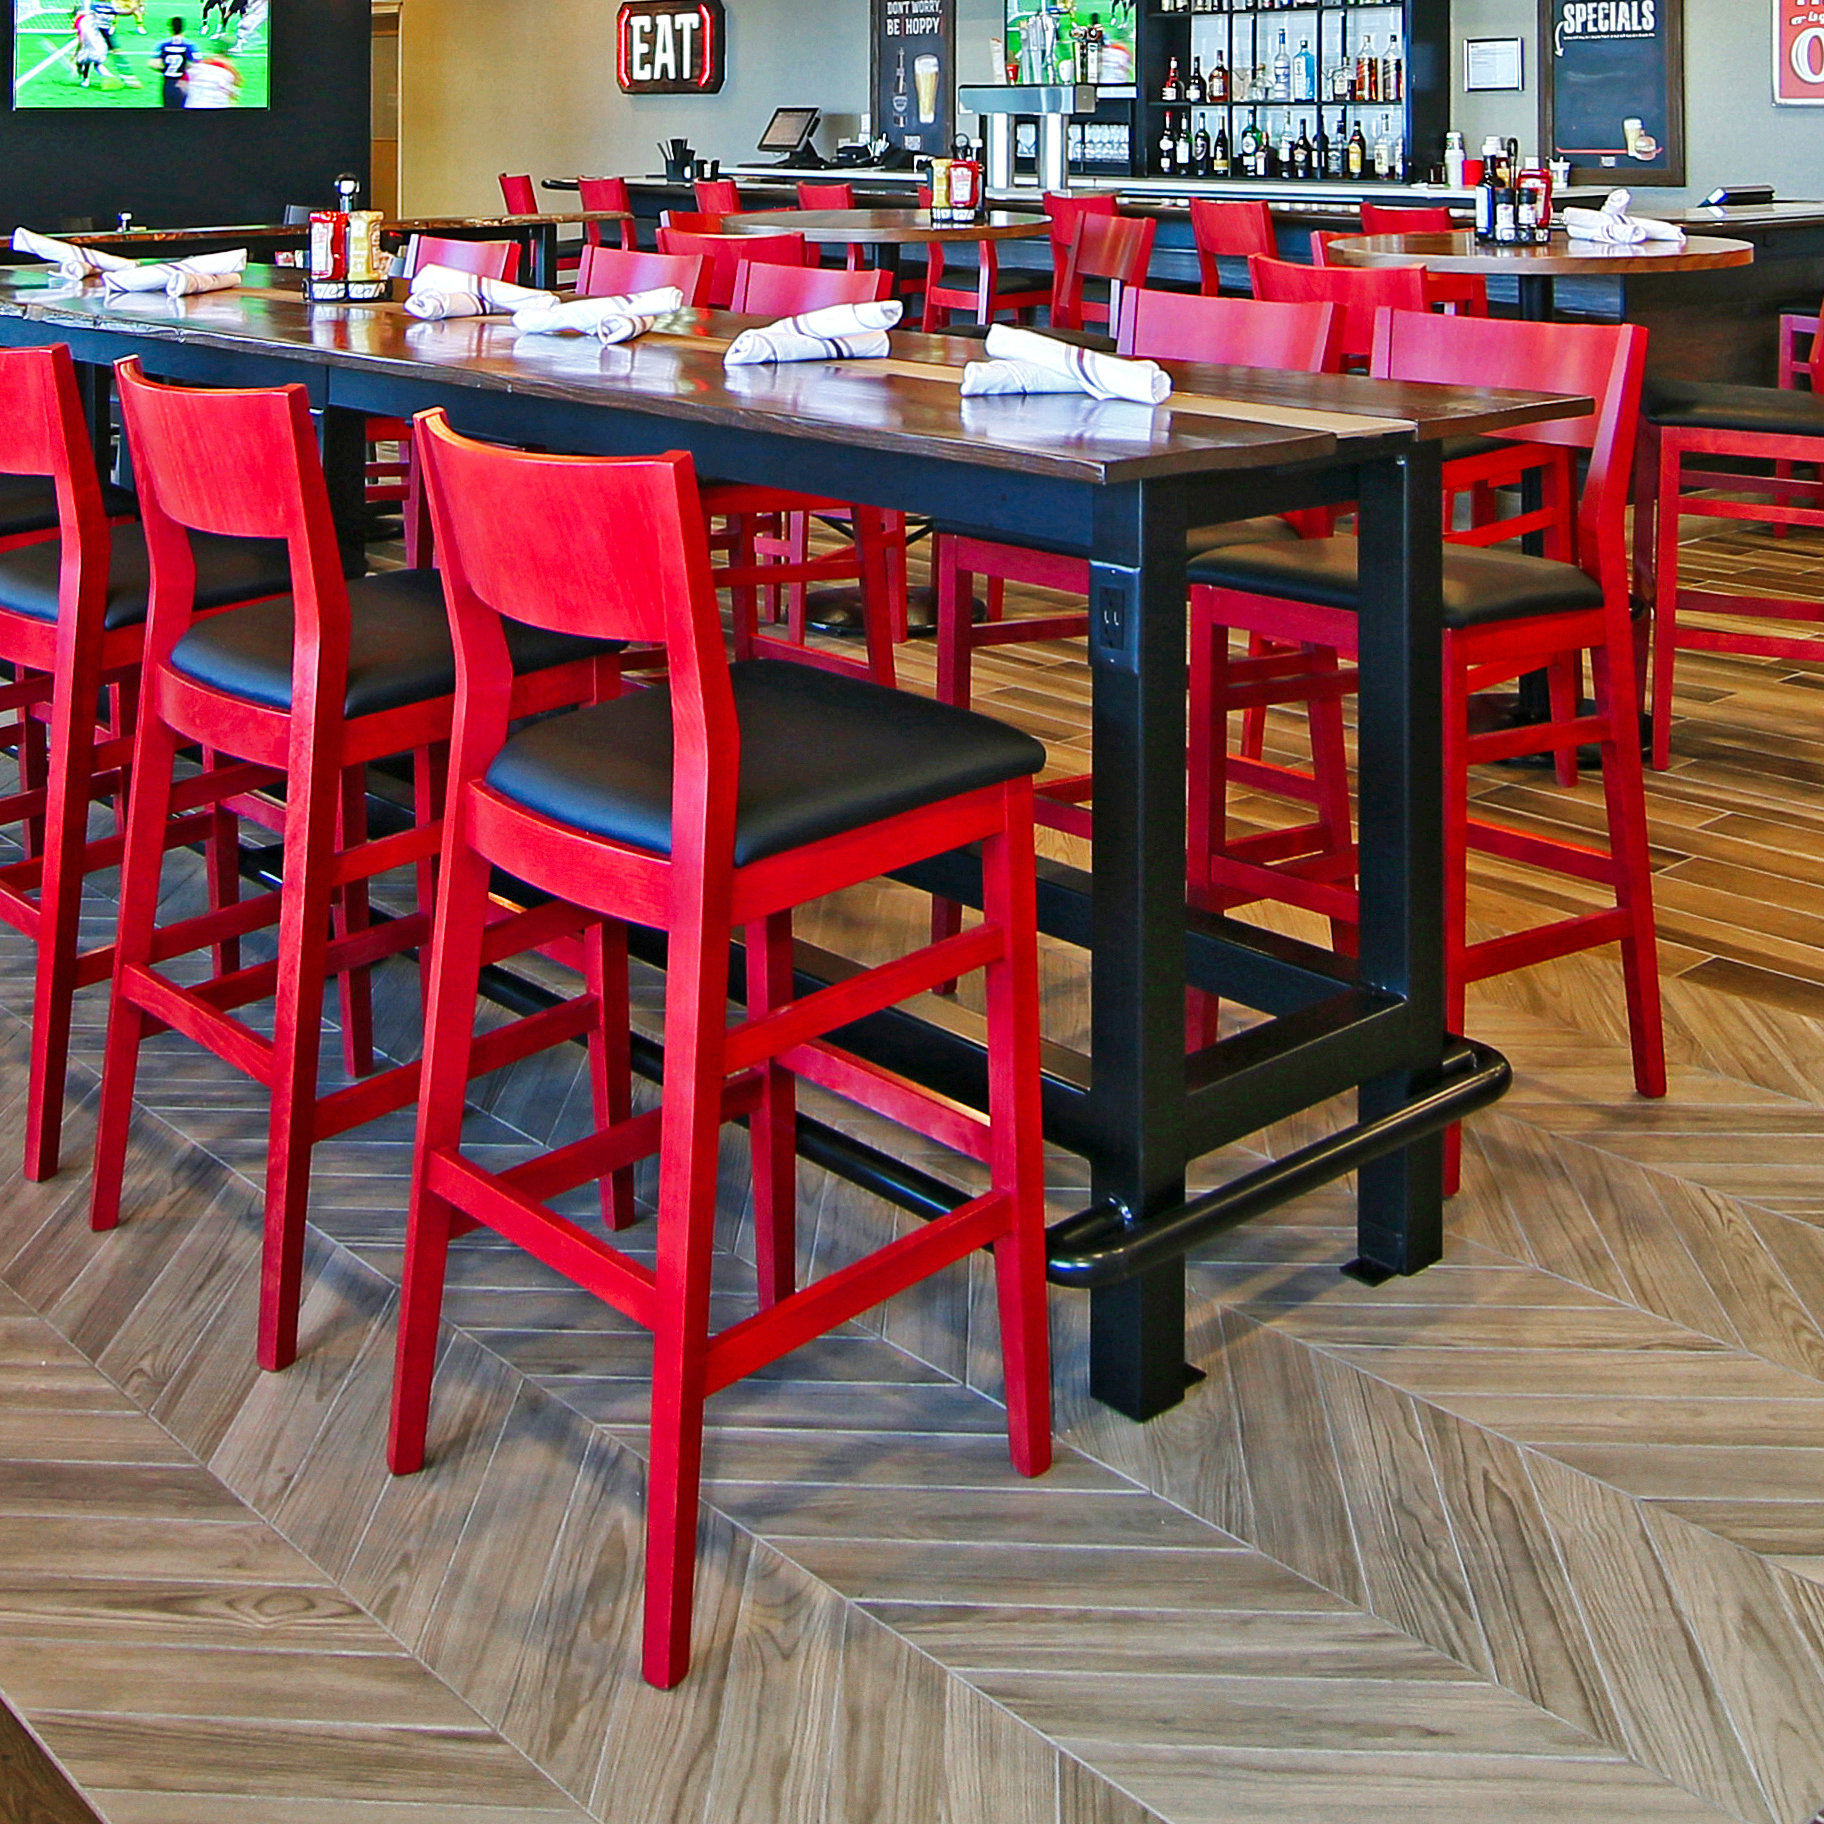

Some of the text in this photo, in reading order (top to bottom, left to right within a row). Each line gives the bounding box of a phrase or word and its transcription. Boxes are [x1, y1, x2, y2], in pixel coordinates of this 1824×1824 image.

[911, 0, 943, 14] WORRY,
[1563, 0, 1655, 34] SPECIALS
[886, 18, 901, 36] BE
